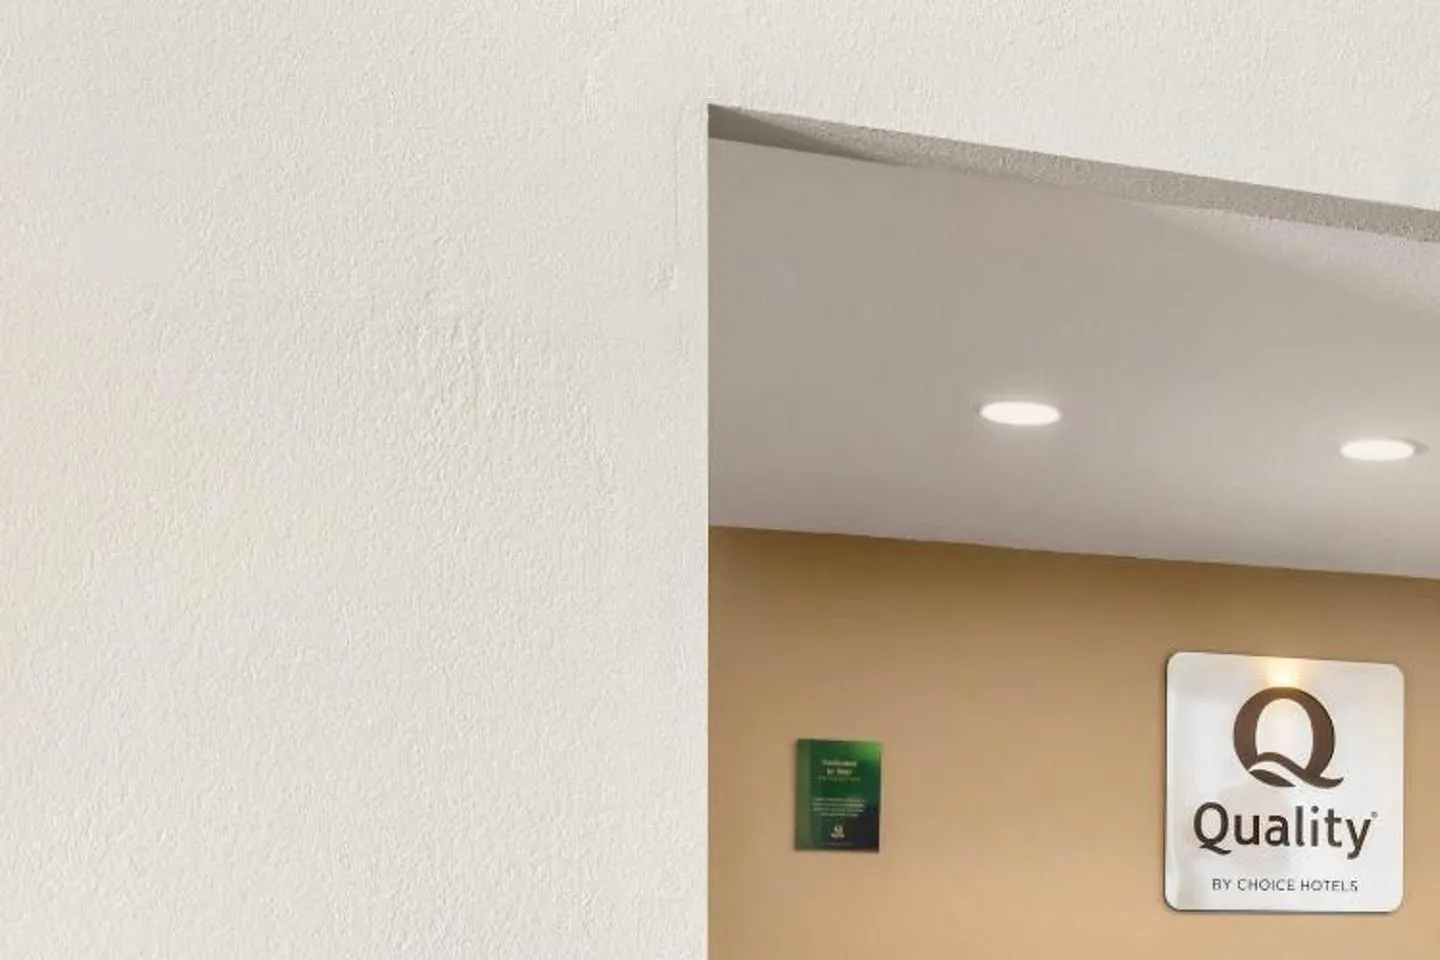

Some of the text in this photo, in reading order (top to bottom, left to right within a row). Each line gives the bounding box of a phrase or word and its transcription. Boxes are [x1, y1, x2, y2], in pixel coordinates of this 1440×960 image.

[1233, 686, 1344, 789] Q
[1193, 801, 1374, 860] Quality
[1212, 878, 1358, 892] BY CHOICE HOTELS
